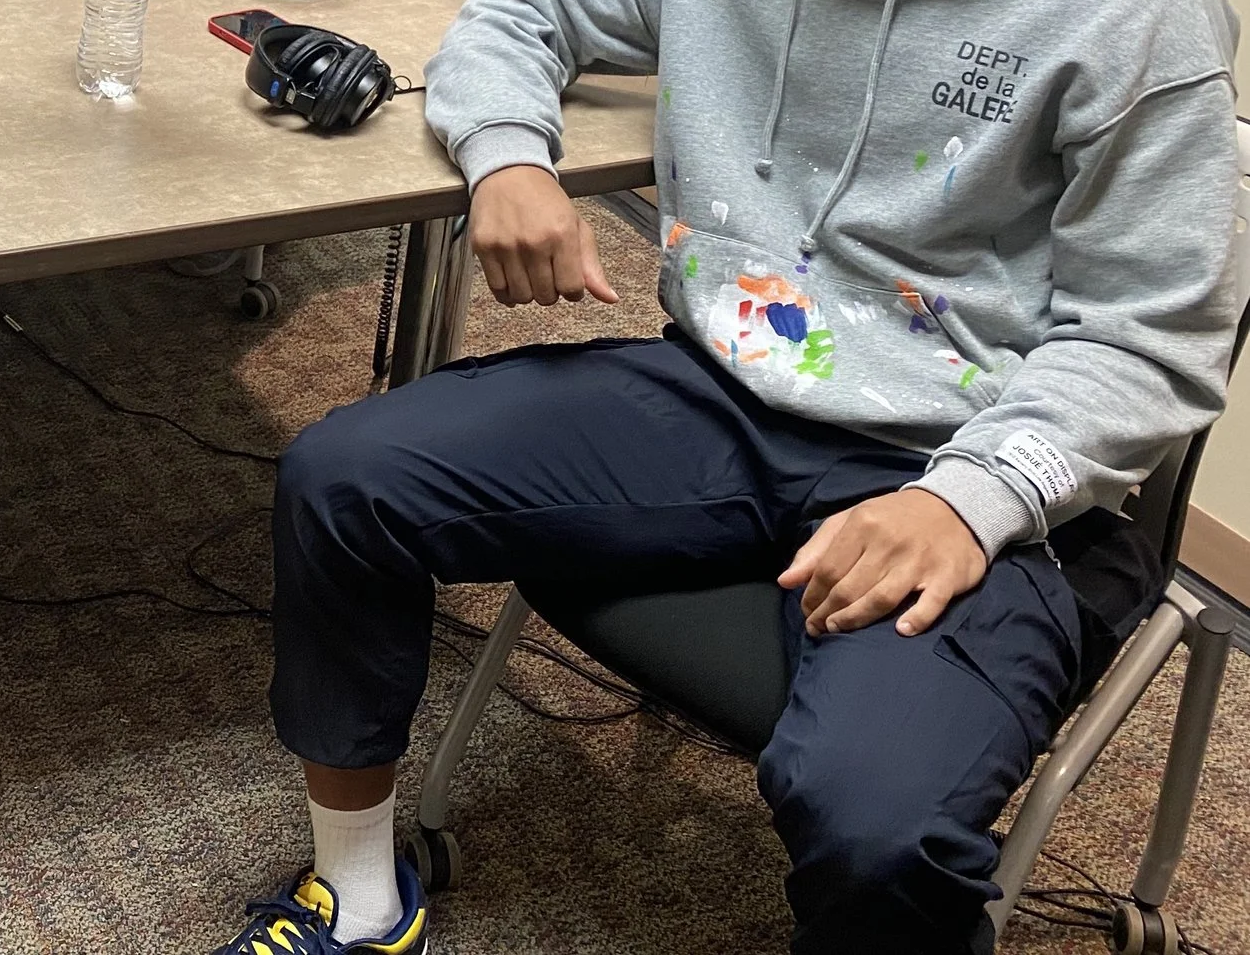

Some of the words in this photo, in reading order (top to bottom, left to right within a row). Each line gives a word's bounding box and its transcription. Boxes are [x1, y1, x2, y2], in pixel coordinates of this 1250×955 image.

[957, 40, 1029, 78] DEPT.
[961, 67, 989, 90] de
[995, 76, 1015, 98] la
[1027, 434, 1046, 447] ART
[1045, 447, 1059, 460] ON
